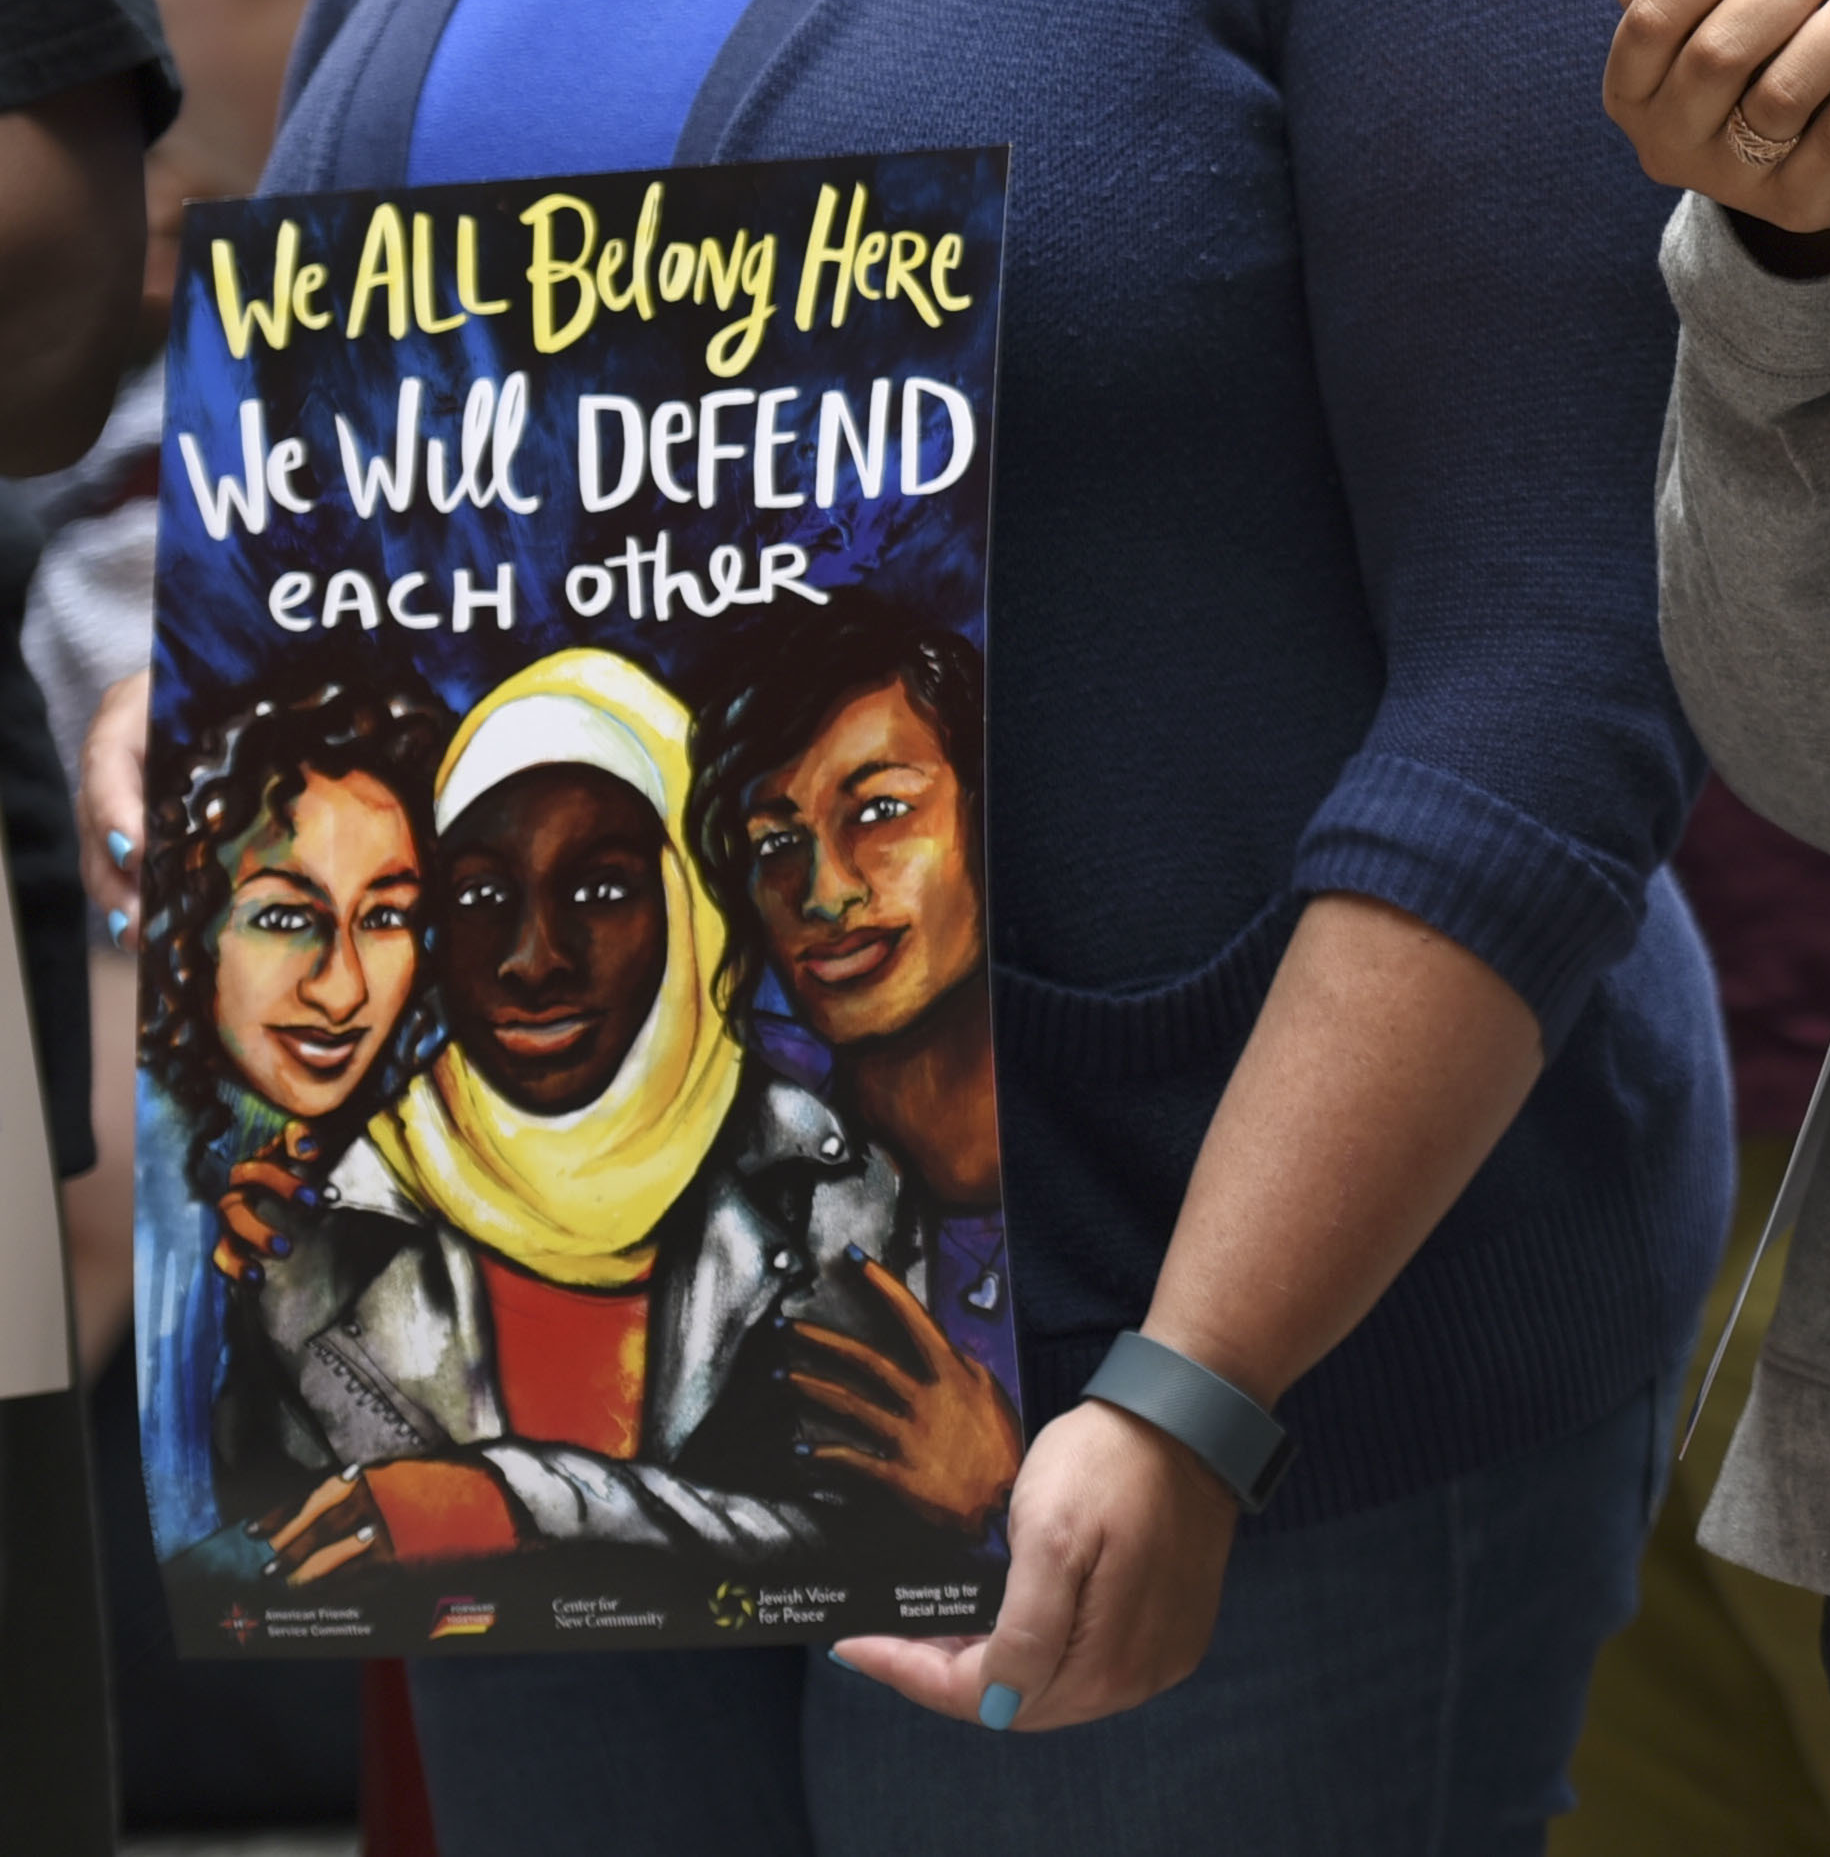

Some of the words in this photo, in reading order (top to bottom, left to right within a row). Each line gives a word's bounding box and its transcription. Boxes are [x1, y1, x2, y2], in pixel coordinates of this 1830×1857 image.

[211, 220, 329, 360] We
[346, 202, 509, 340] ALL
[180, 397, 314, 541] We
[335, 370, 540, 519] Will
[757, 1589, 802, 1606] Jewish
[806, 1588, 846, 1603] Voice
[895, 1586, 941, 1602] Showing
[945, 1585, 959, 1601] Up
[961, 1584, 979, 1598] for
[552, 1598, 597, 1614] Center
[597, 1597, 618, 1613] for
[900, 1604, 932, 1617] Racial
[935, 1602, 976, 1616] Justice
[554, 1614, 584, 1629] New
[585, 1611, 665, 1630] Community
[758, 1608, 780, 1624] for
[783, 1607, 825, 1623] Peace
